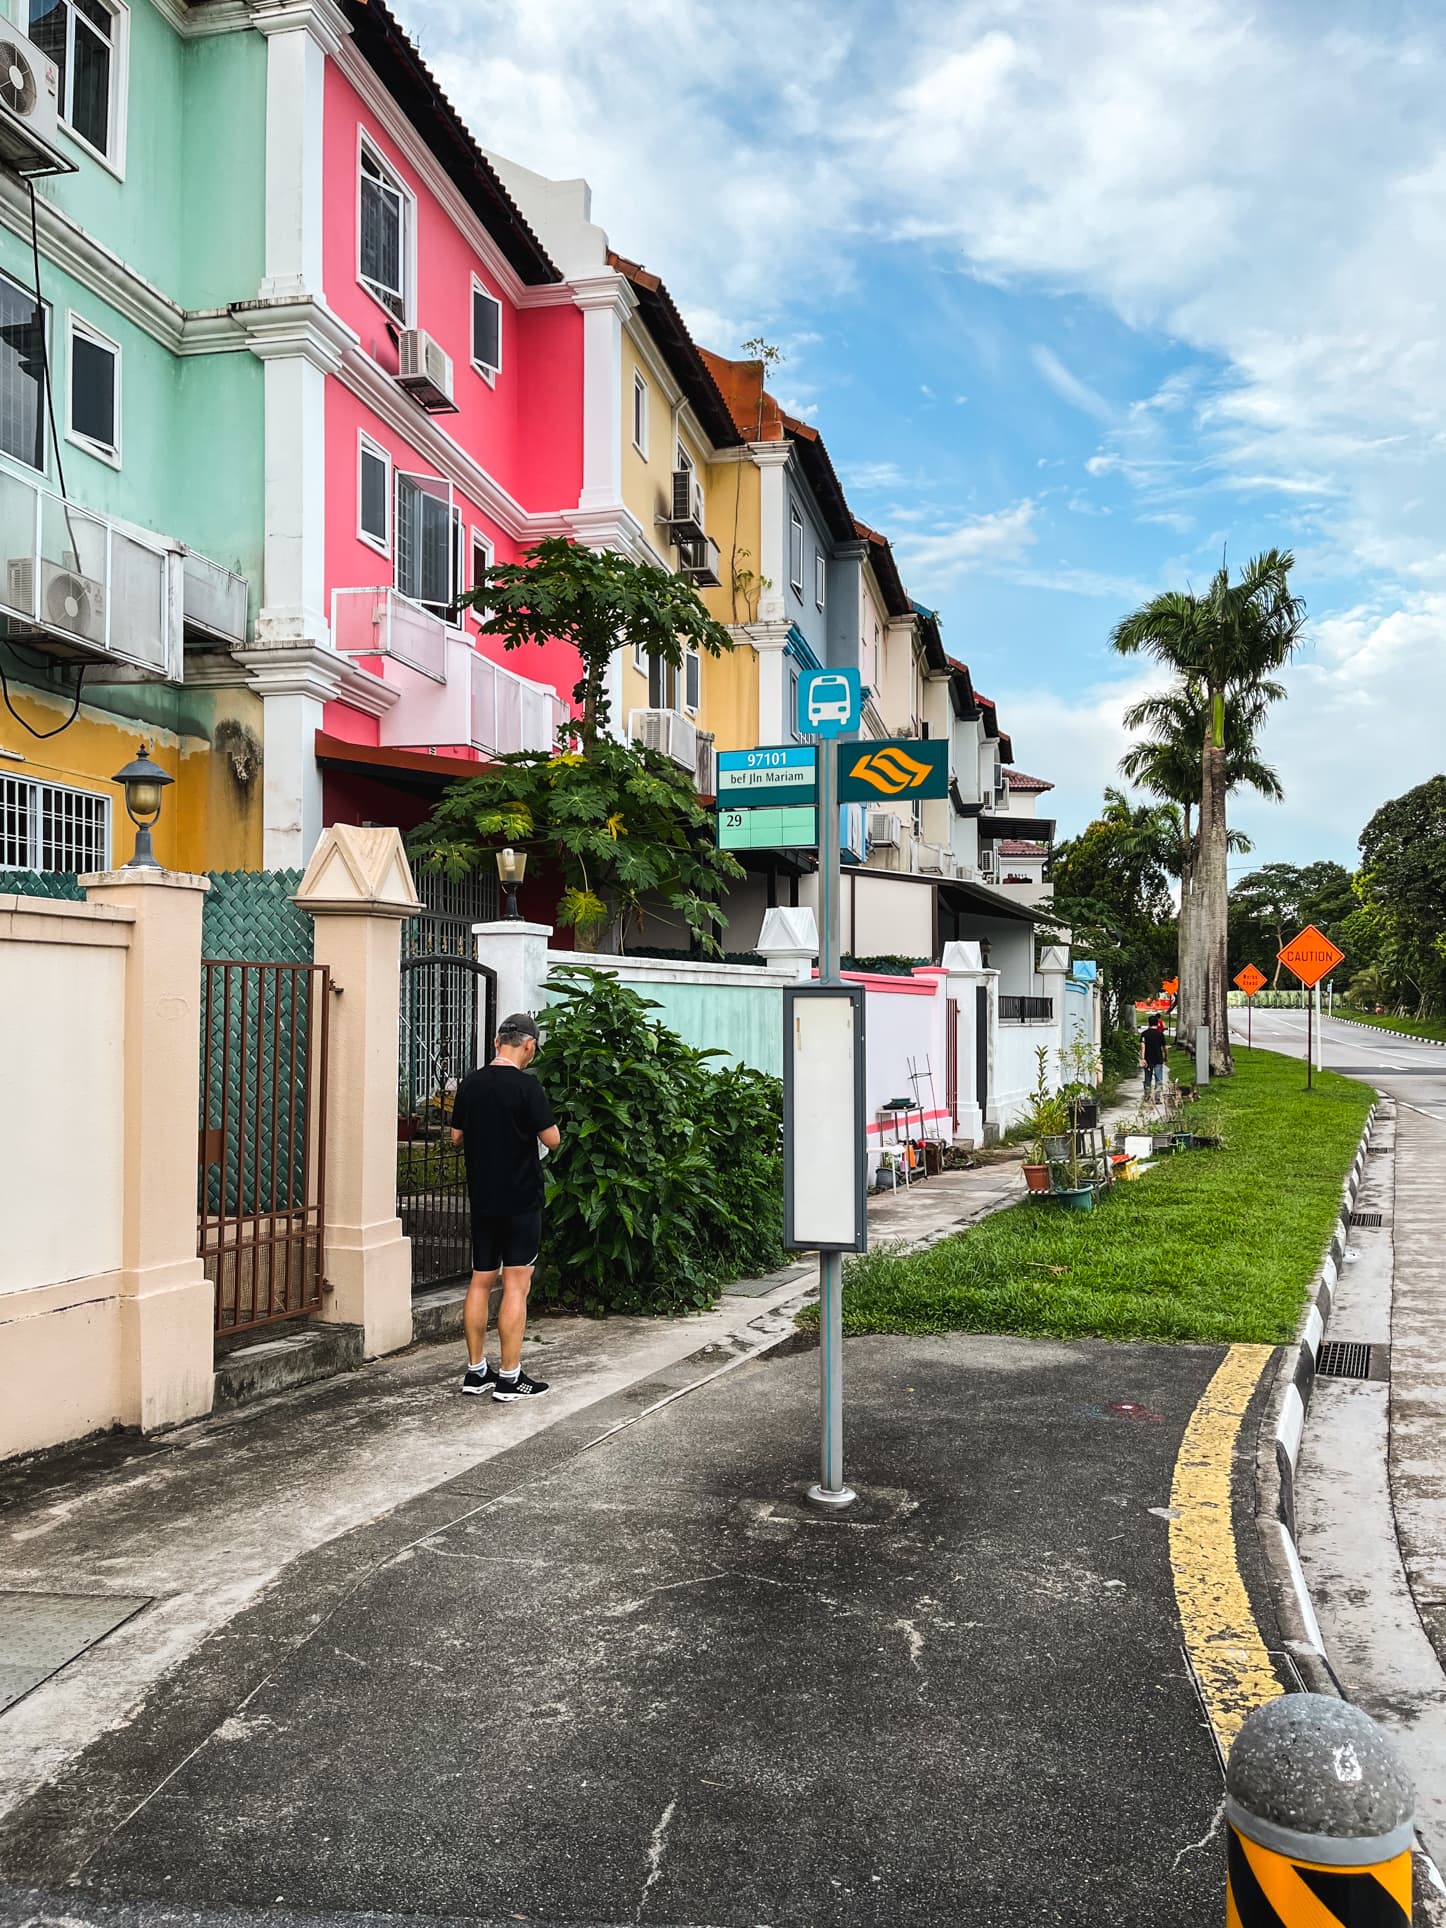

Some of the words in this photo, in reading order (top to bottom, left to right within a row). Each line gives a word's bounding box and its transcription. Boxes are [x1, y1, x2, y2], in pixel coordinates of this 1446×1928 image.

[747, 752, 787, 767] 97101
[730, 773, 746, 784] bef
[749, 772, 762, 785] Jln
[765, 771, 804, 782] Mariam
[726, 814, 742, 827] 29
[1287, 951, 1333, 962] CAUTION
